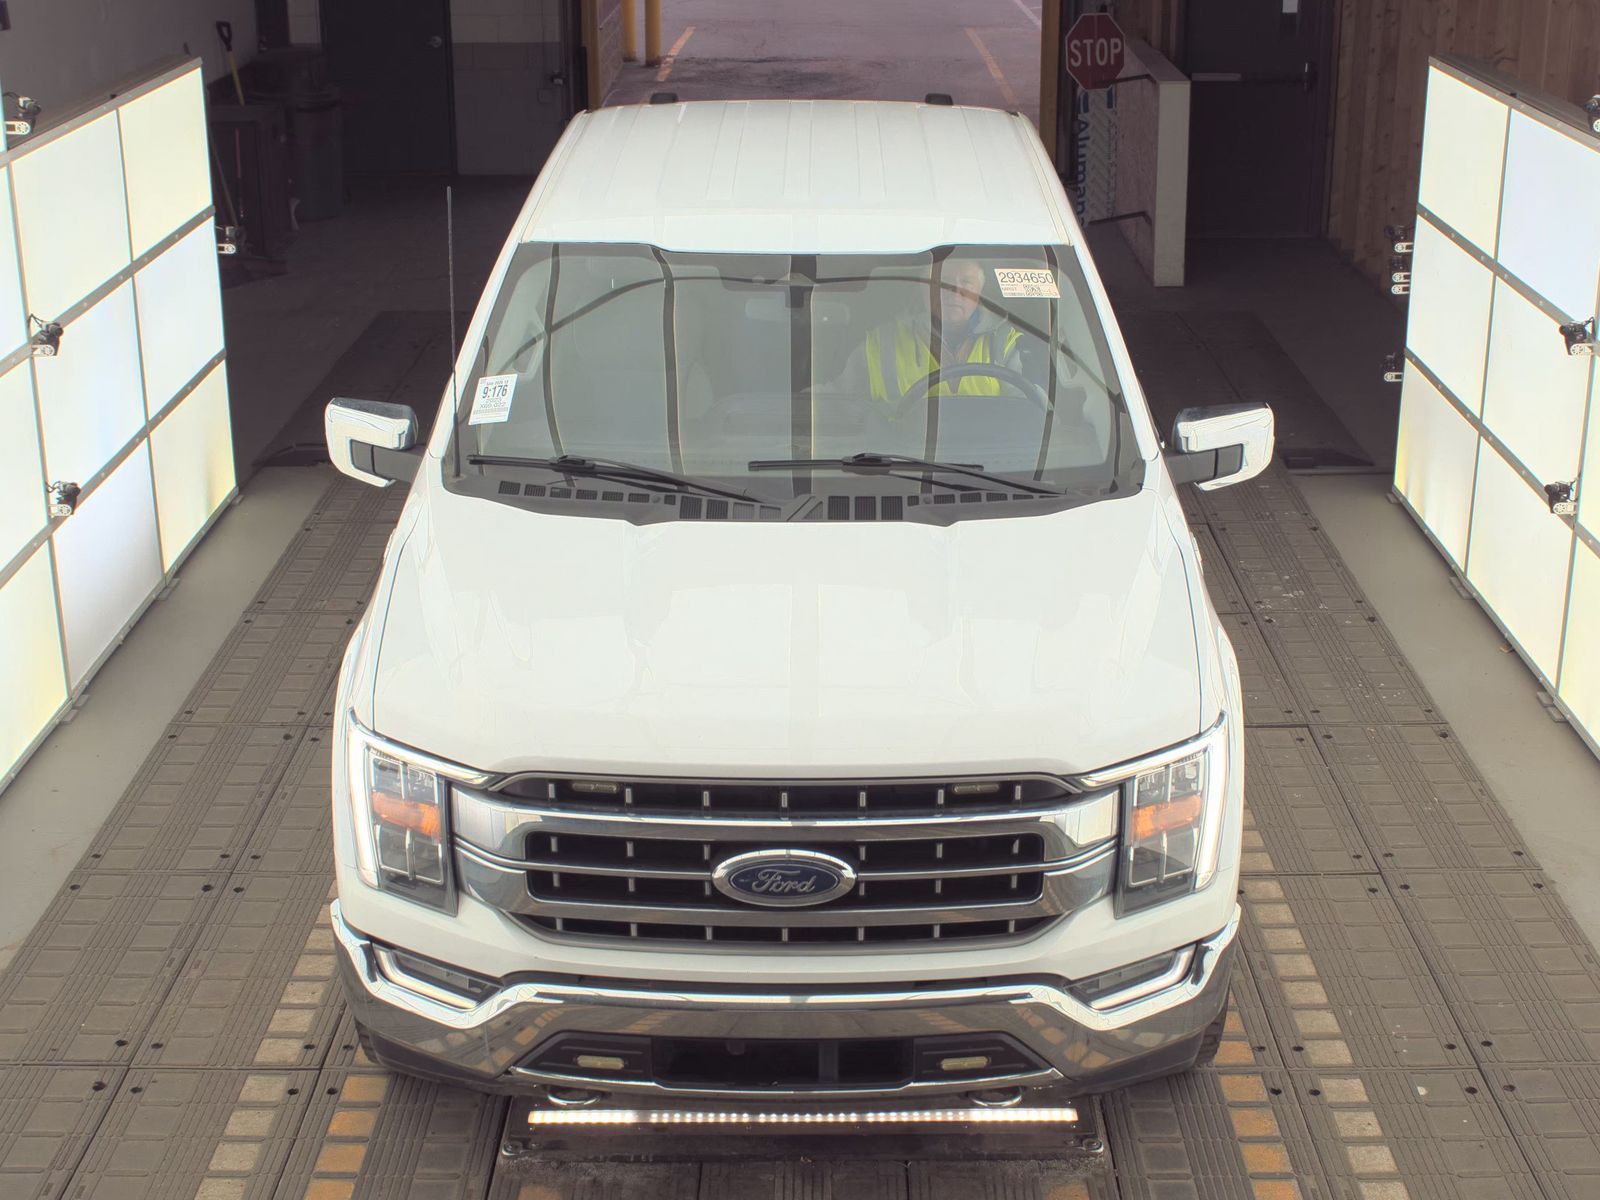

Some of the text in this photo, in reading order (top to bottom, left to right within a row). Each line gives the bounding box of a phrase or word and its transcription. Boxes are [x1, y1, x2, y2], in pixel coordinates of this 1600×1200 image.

[1070, 38, 1122, 68] STOP
[998, 271, 1054, 284] 2934650
[751, 868, 817, 893] Ford
